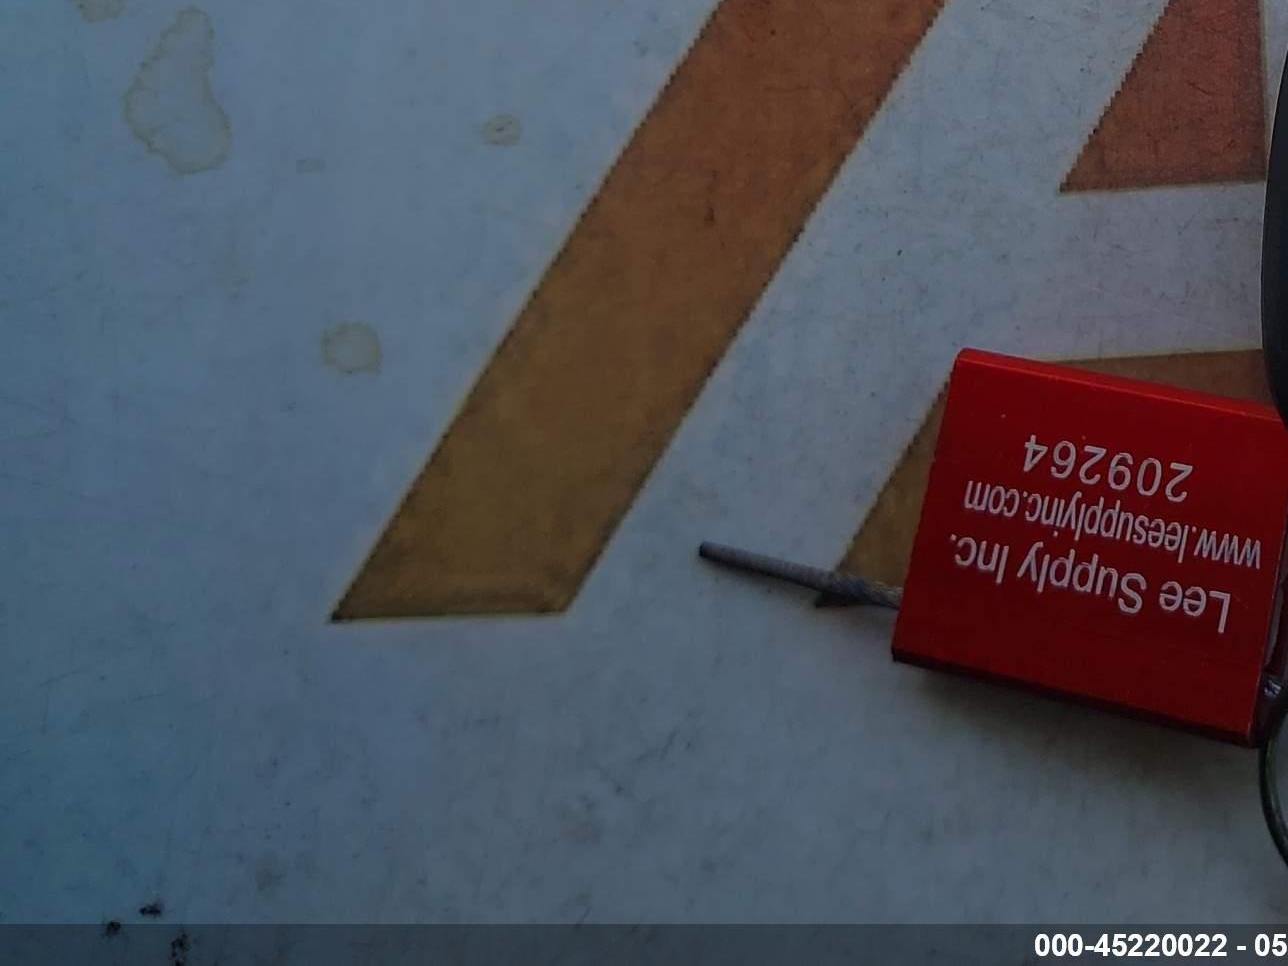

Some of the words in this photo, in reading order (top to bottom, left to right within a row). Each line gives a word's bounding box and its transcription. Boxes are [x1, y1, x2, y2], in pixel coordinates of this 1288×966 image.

[1022, 434, 1193, 503] 209264
[949, 533, 1010, 585] Inc.
[963, 480, 1262, 570] www.leesupplyinc.com
[1016, 541, 1148, 614] Supply
[1159, 581, 1231, 634] Lee
